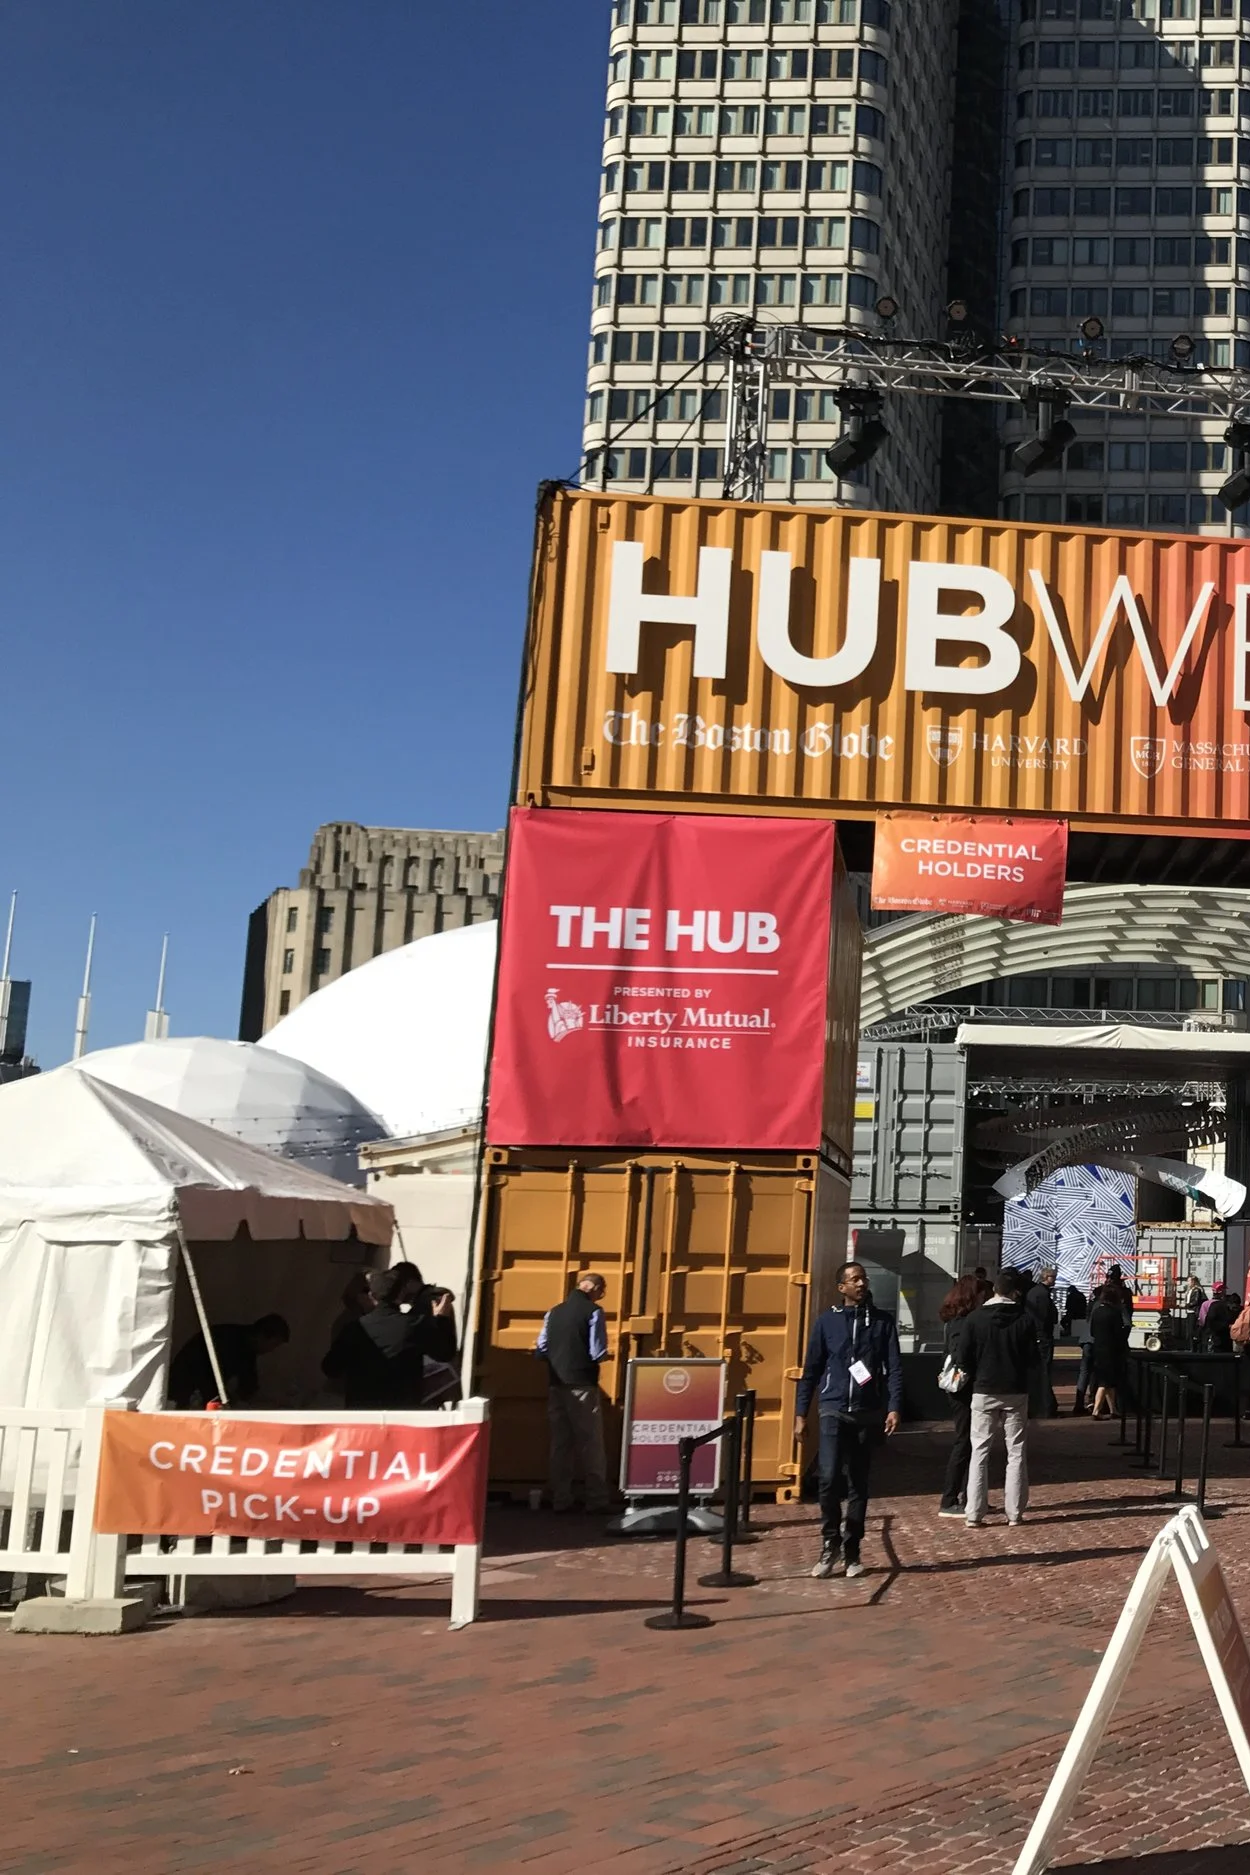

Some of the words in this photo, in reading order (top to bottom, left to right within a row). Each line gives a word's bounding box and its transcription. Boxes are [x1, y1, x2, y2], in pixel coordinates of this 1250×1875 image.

[602, 709, 666, 747] The
[672, 713, 794, 755] Boston
[800, 721, 895, 761] Globe
[972, 731, 1088, 756] HARVARD
[991, 756, 1070, 770] UNIVERSITY
[1171, 756, 1244, 773] GENERAL
[900, 838, 1043, 862] CREDENTIAL
[918, 860, 1025, 883] HOLDERS
[550, 905, 651, 950] THE
[664, 910, 781, 953] HUB
[613, 986, 691, 998] PRESENTED
[694, 989, 712, 998] BY
[588, 1004, 677, 1034] Liberty
[627, 1036, 732, 1049] INSURANCE
[633, 1424, 711, 1433] CREDENTIAL
[149, 1441, 439, 1484] CREDENTIAL
[201, 1488, 380, 1524] PICK-UP
